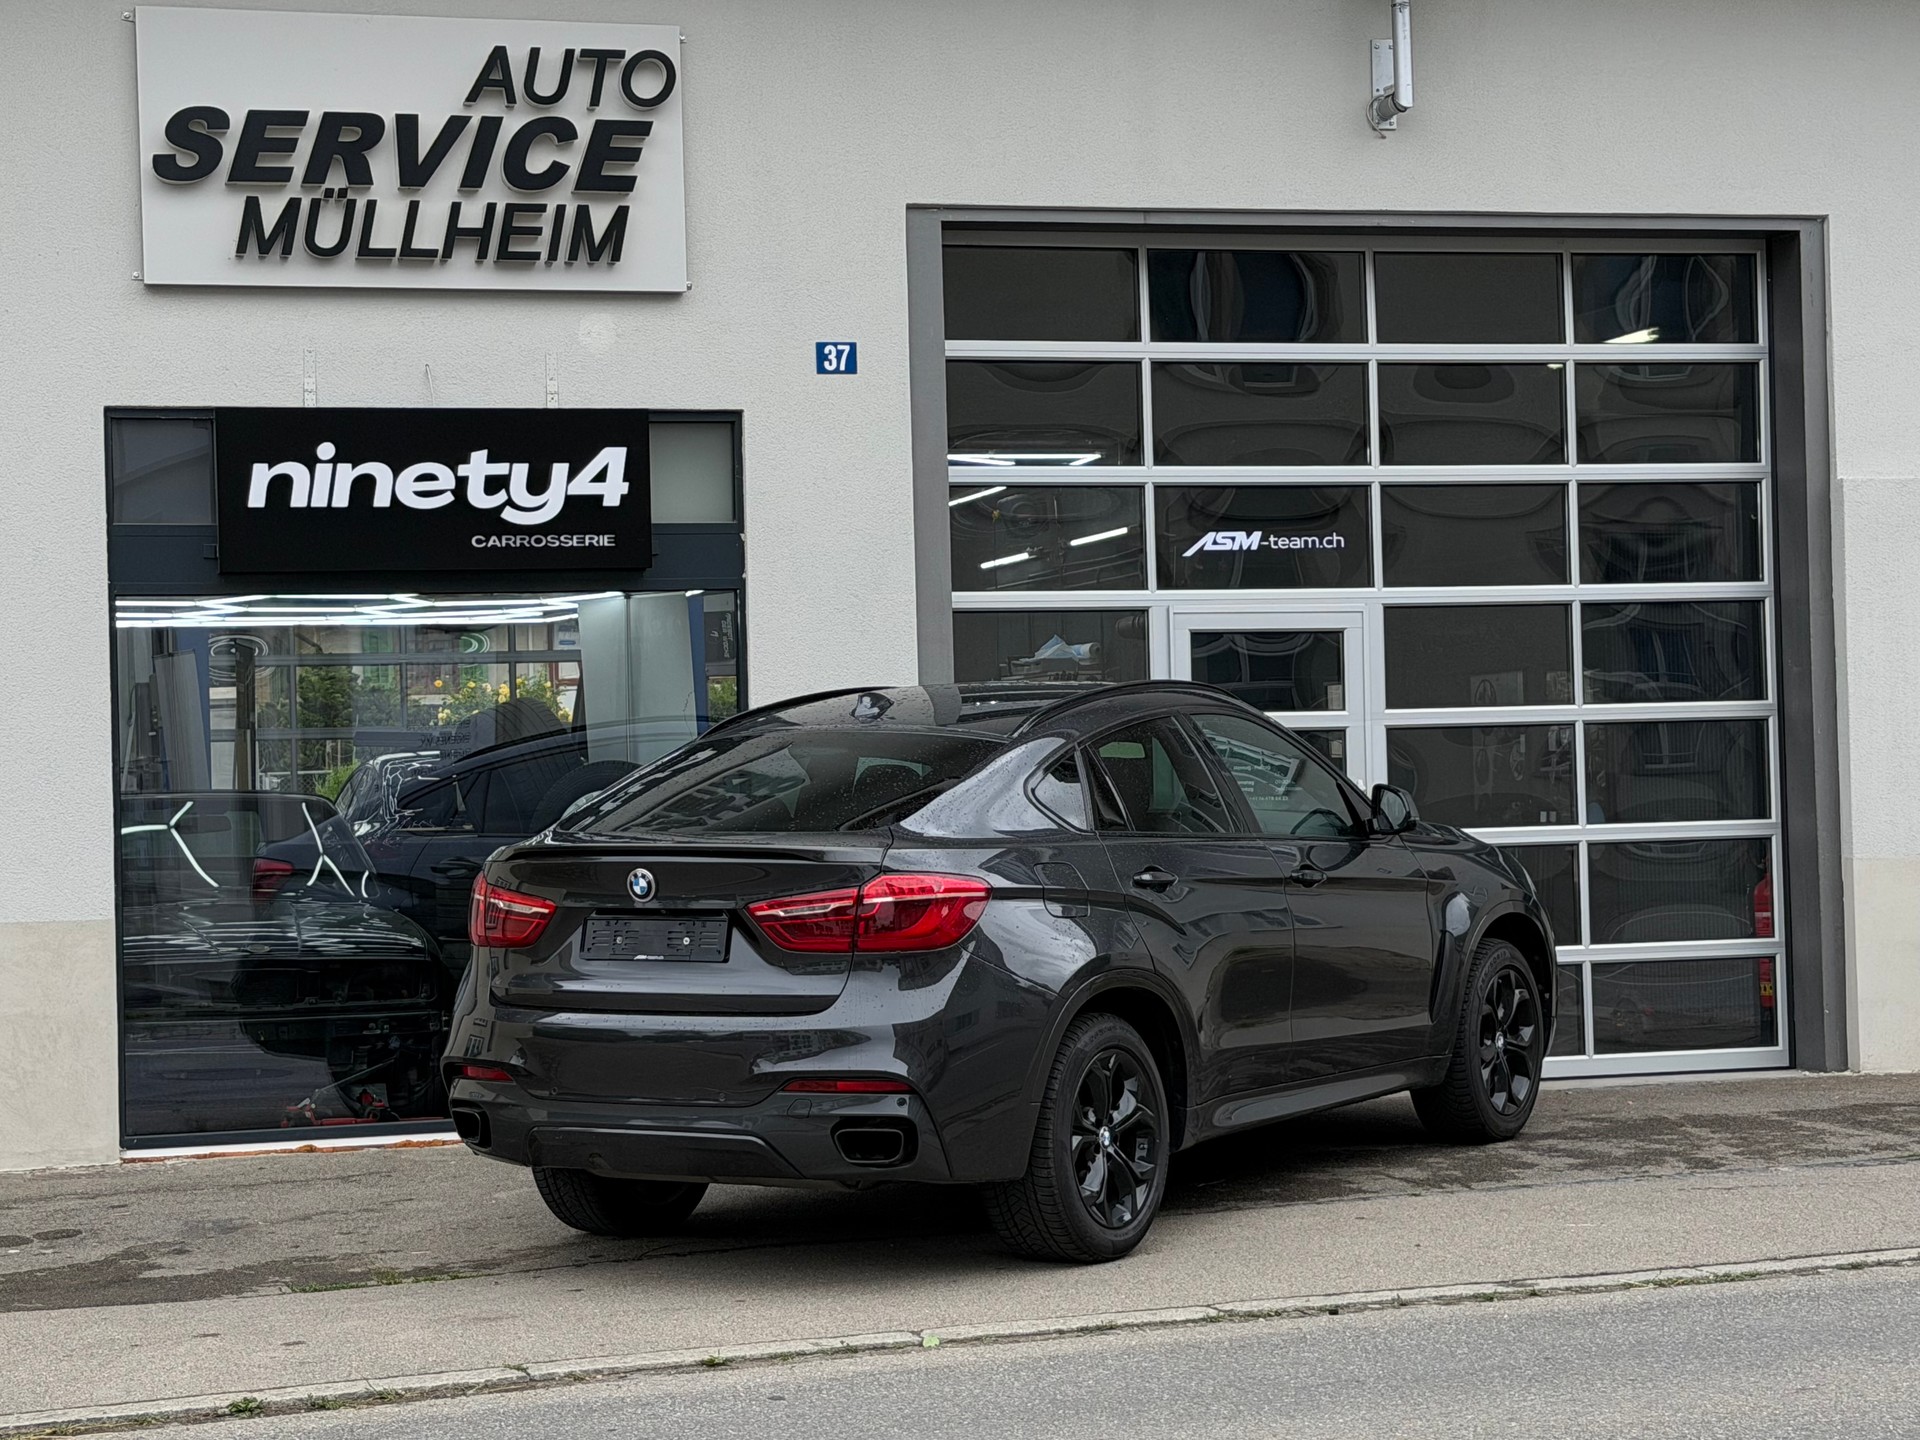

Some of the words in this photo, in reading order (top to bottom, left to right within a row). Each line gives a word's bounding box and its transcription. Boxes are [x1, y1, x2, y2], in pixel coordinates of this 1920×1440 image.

[464, 45, 677, 108] AUTO
[152, 106, 654, 193] SERVICE
[235, 187, 631, 266] MÜLLHEIM
[823, 344, 851, 371] 37
[247, 441, 630, 525] ninety4
[471, 534, 616, 548] CARROSSERIE
[1182, 530, 1346, 557] ASM-team.ch
